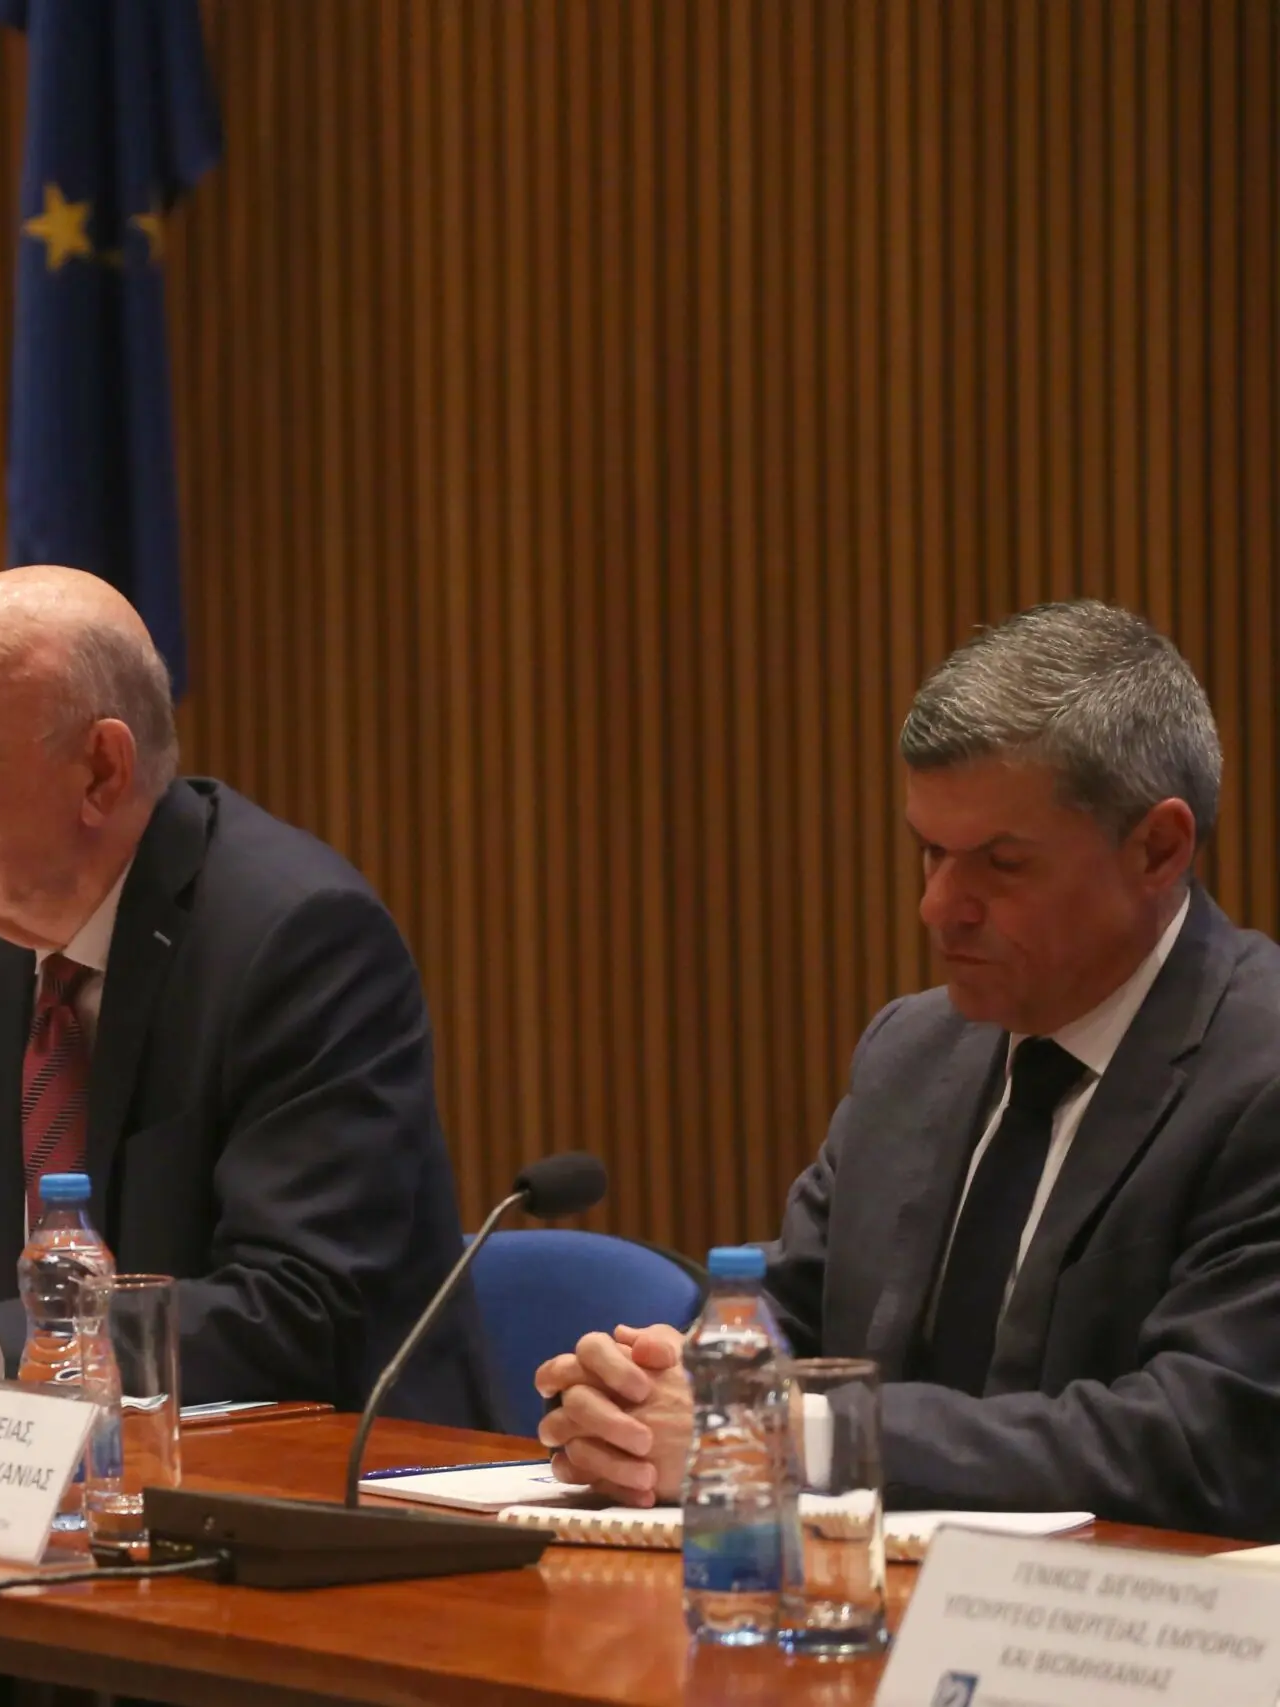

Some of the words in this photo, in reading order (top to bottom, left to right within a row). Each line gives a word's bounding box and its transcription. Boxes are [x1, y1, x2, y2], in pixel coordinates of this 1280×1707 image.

[1013, 1562, 1092, 1592] ΓΕΝΙΚΟΣ
[1156, 1624, 1267, 1660] ΕΜΠΟΡΙΟΥ
[1000, 1645, 1031, 1668] ΚΑΙ
[1035, 1651, 1172, 1690] ΒΙΟΜΗΧΑΝΙΑΣ
